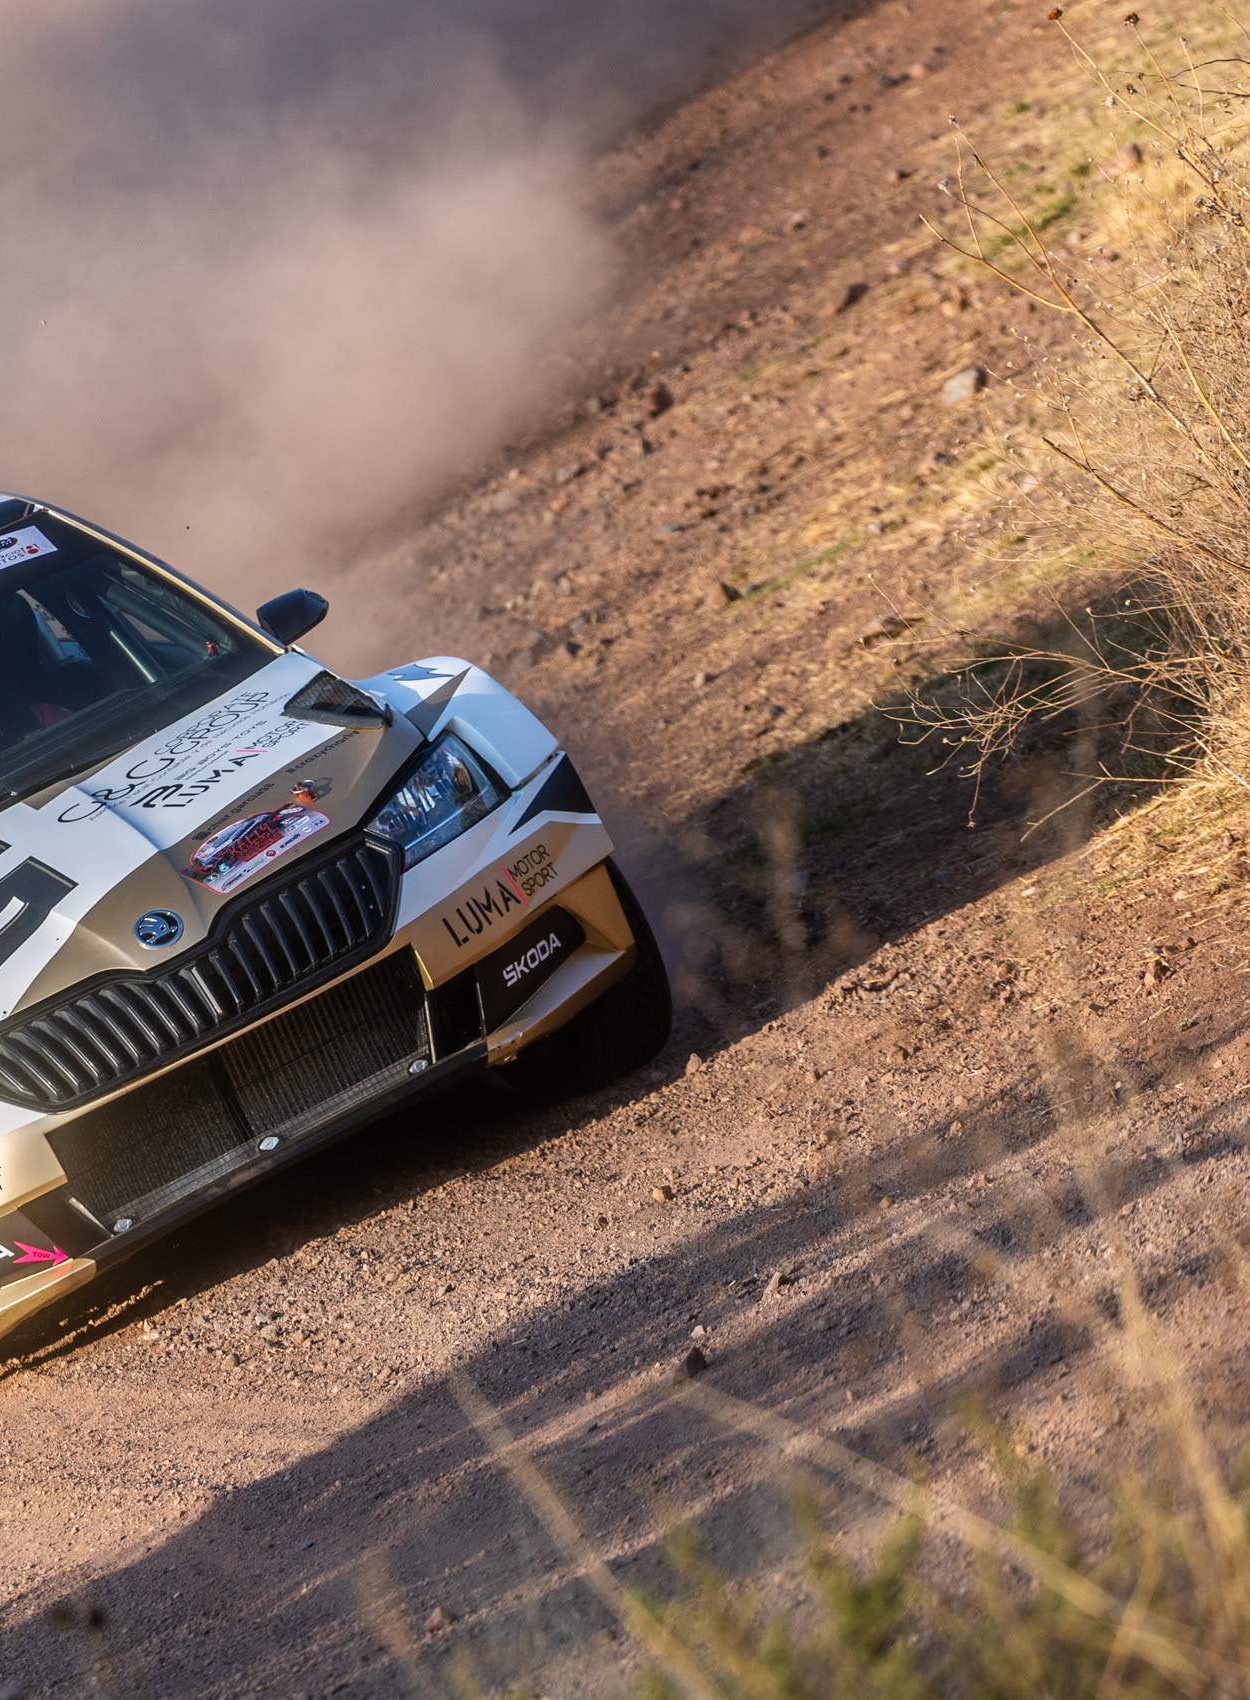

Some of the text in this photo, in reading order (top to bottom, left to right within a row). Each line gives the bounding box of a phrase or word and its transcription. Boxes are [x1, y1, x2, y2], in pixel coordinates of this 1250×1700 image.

[154, 691, 261, 755] CORPORATE
[170, 692, 269, 755] GROUP
[231, 720, 268, 741] TOYS
[244, 720, 298, 749] MOTOR
[262, 722, 311, 748] SPORT
[286, 729, 360, 774] #crazycharly
[162, 753, 260, 808] LUMA
[192, 783, 275, 841] @char.garcia98
[507, 844, 551, 882] MOTOR
[521, 862, 558, 897] SPORT
[441, 879, 521, 948] LUMA
[502, 932, 562, 988] SKODA
[31, 1250, 51, 1259] TOW
